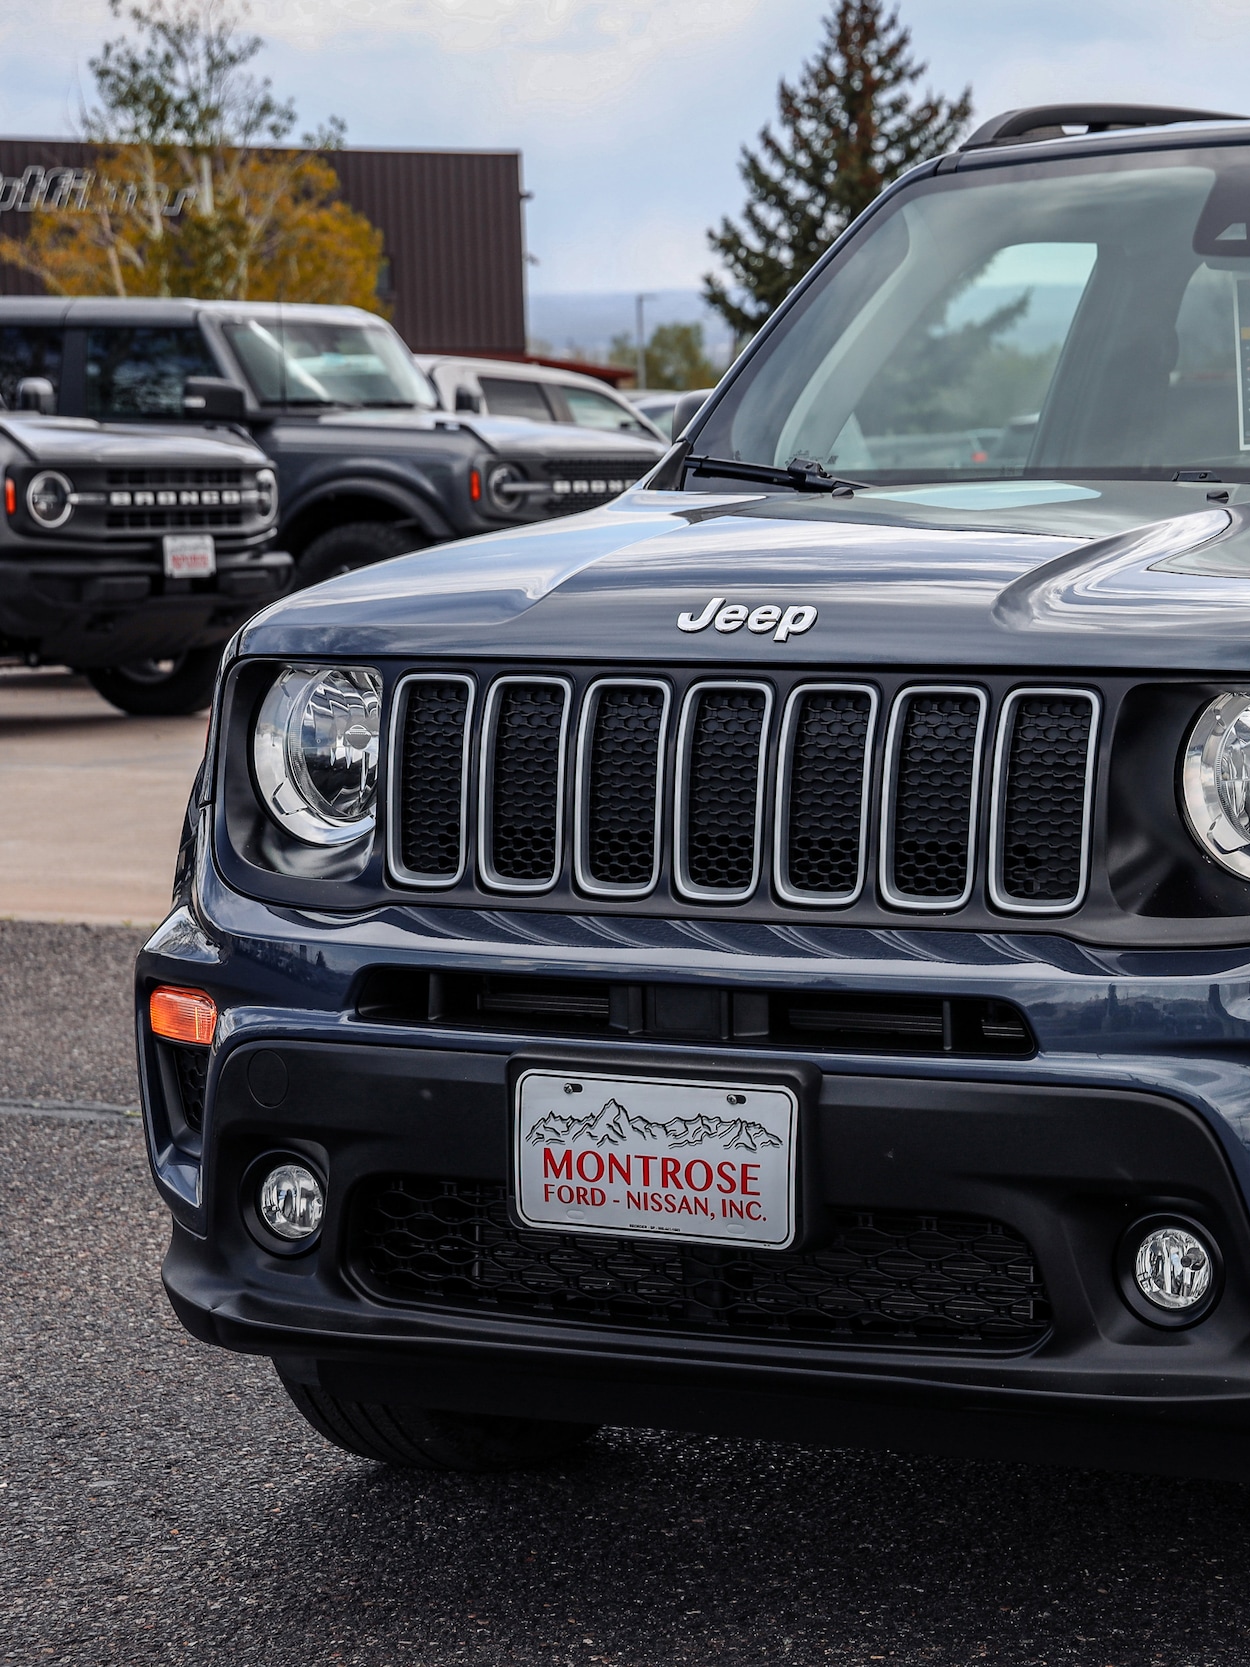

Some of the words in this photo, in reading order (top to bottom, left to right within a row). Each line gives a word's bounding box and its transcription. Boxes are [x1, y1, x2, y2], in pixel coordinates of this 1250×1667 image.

[110, 491, 240, 506] BRONCO
[677, 597, 817, 642] Jeep
[543, 1147, 761, 1196] MONTROSE
[543, 1183, 606, 1207] FORD
[627, 1190, 715, 1221] NISSAN,
[721, 1199, 767, 1222] INC.
